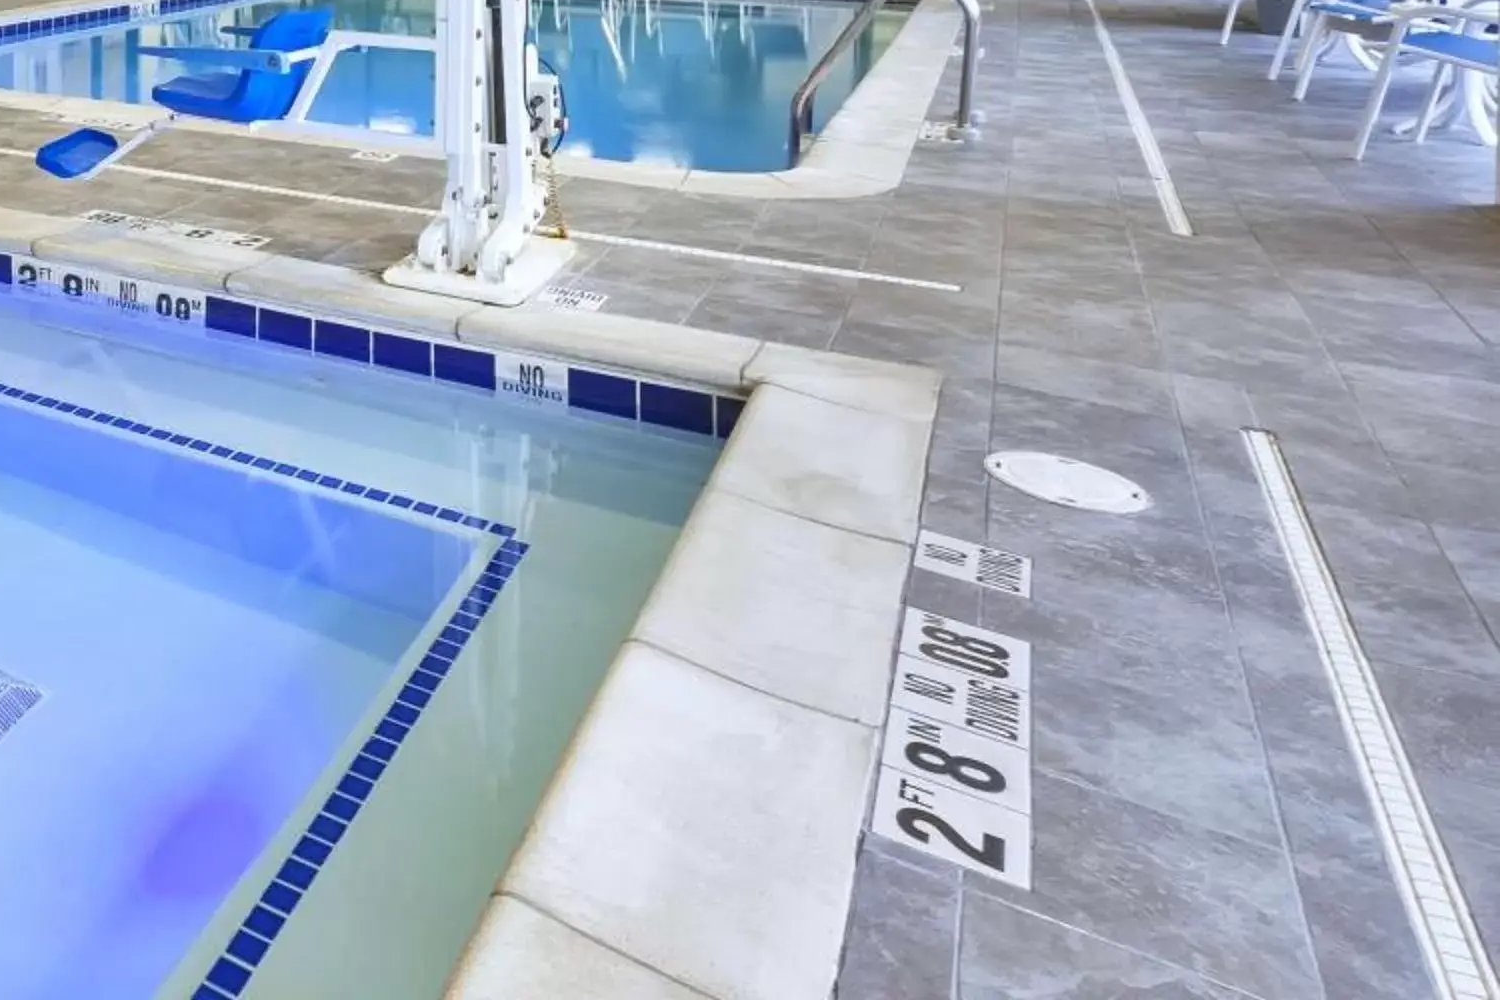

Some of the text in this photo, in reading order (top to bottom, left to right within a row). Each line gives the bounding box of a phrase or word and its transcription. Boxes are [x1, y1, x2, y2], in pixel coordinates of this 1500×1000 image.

[119, 279, 137, 302] NO
[519, 363, 545, 388] NO
[903, 672, 956, 705] NO
[964, 678, 1020, 742] DIVING
